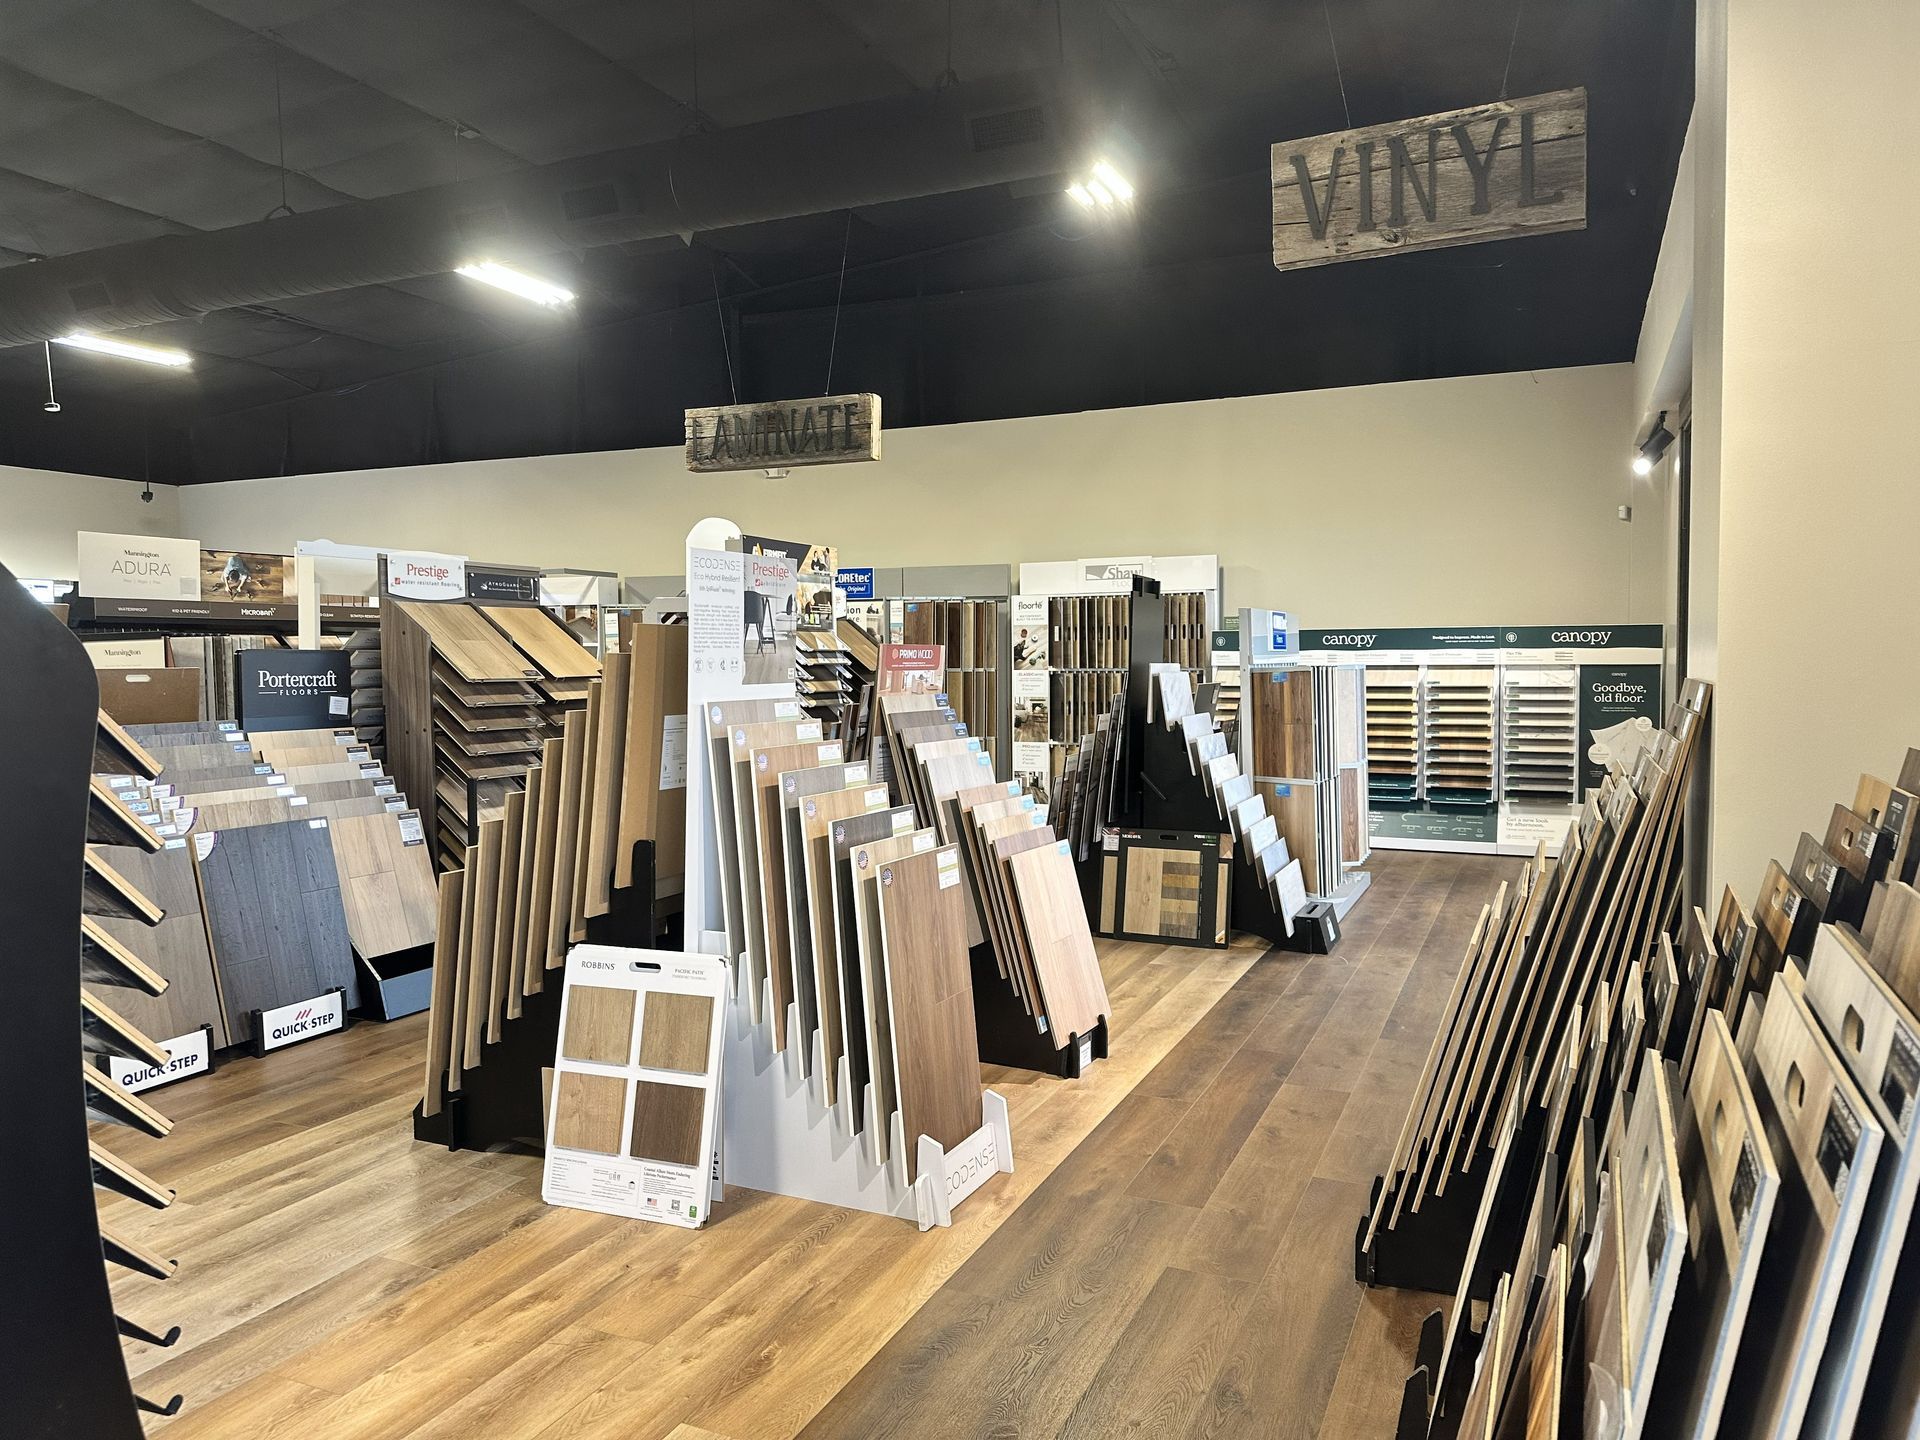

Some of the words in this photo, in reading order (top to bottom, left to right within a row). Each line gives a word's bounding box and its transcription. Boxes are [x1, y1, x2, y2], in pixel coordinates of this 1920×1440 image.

[1289, 113, 1564, 240] VINYL
[692, 403, 862, 464] LAMINATE
[124, 549, 160, 558] Mannington
[111, 560, 172, 576] ADURA
[694, 556, 740, 571] ECODENSE
[407, 563, 449, 580] Prestige
[752, 562, 789, 580] Prestige
[847, 586, 867, 595] Original
[1322, 634, 1377, 647] canopy
[1551, 631, 1612, 645] canopy
[899, 649, 917, 659] PRIMO
[918, 650, 934, 659] WOOD
[258, 670, 337, 688] Portercraft
[1592, 683, 1647, 694] Goodbye,
[1594, 693, 1612, 702] old
[1615, 693, 1645, 702] floor.
[581, 961, 616, 970] ROBBINS
